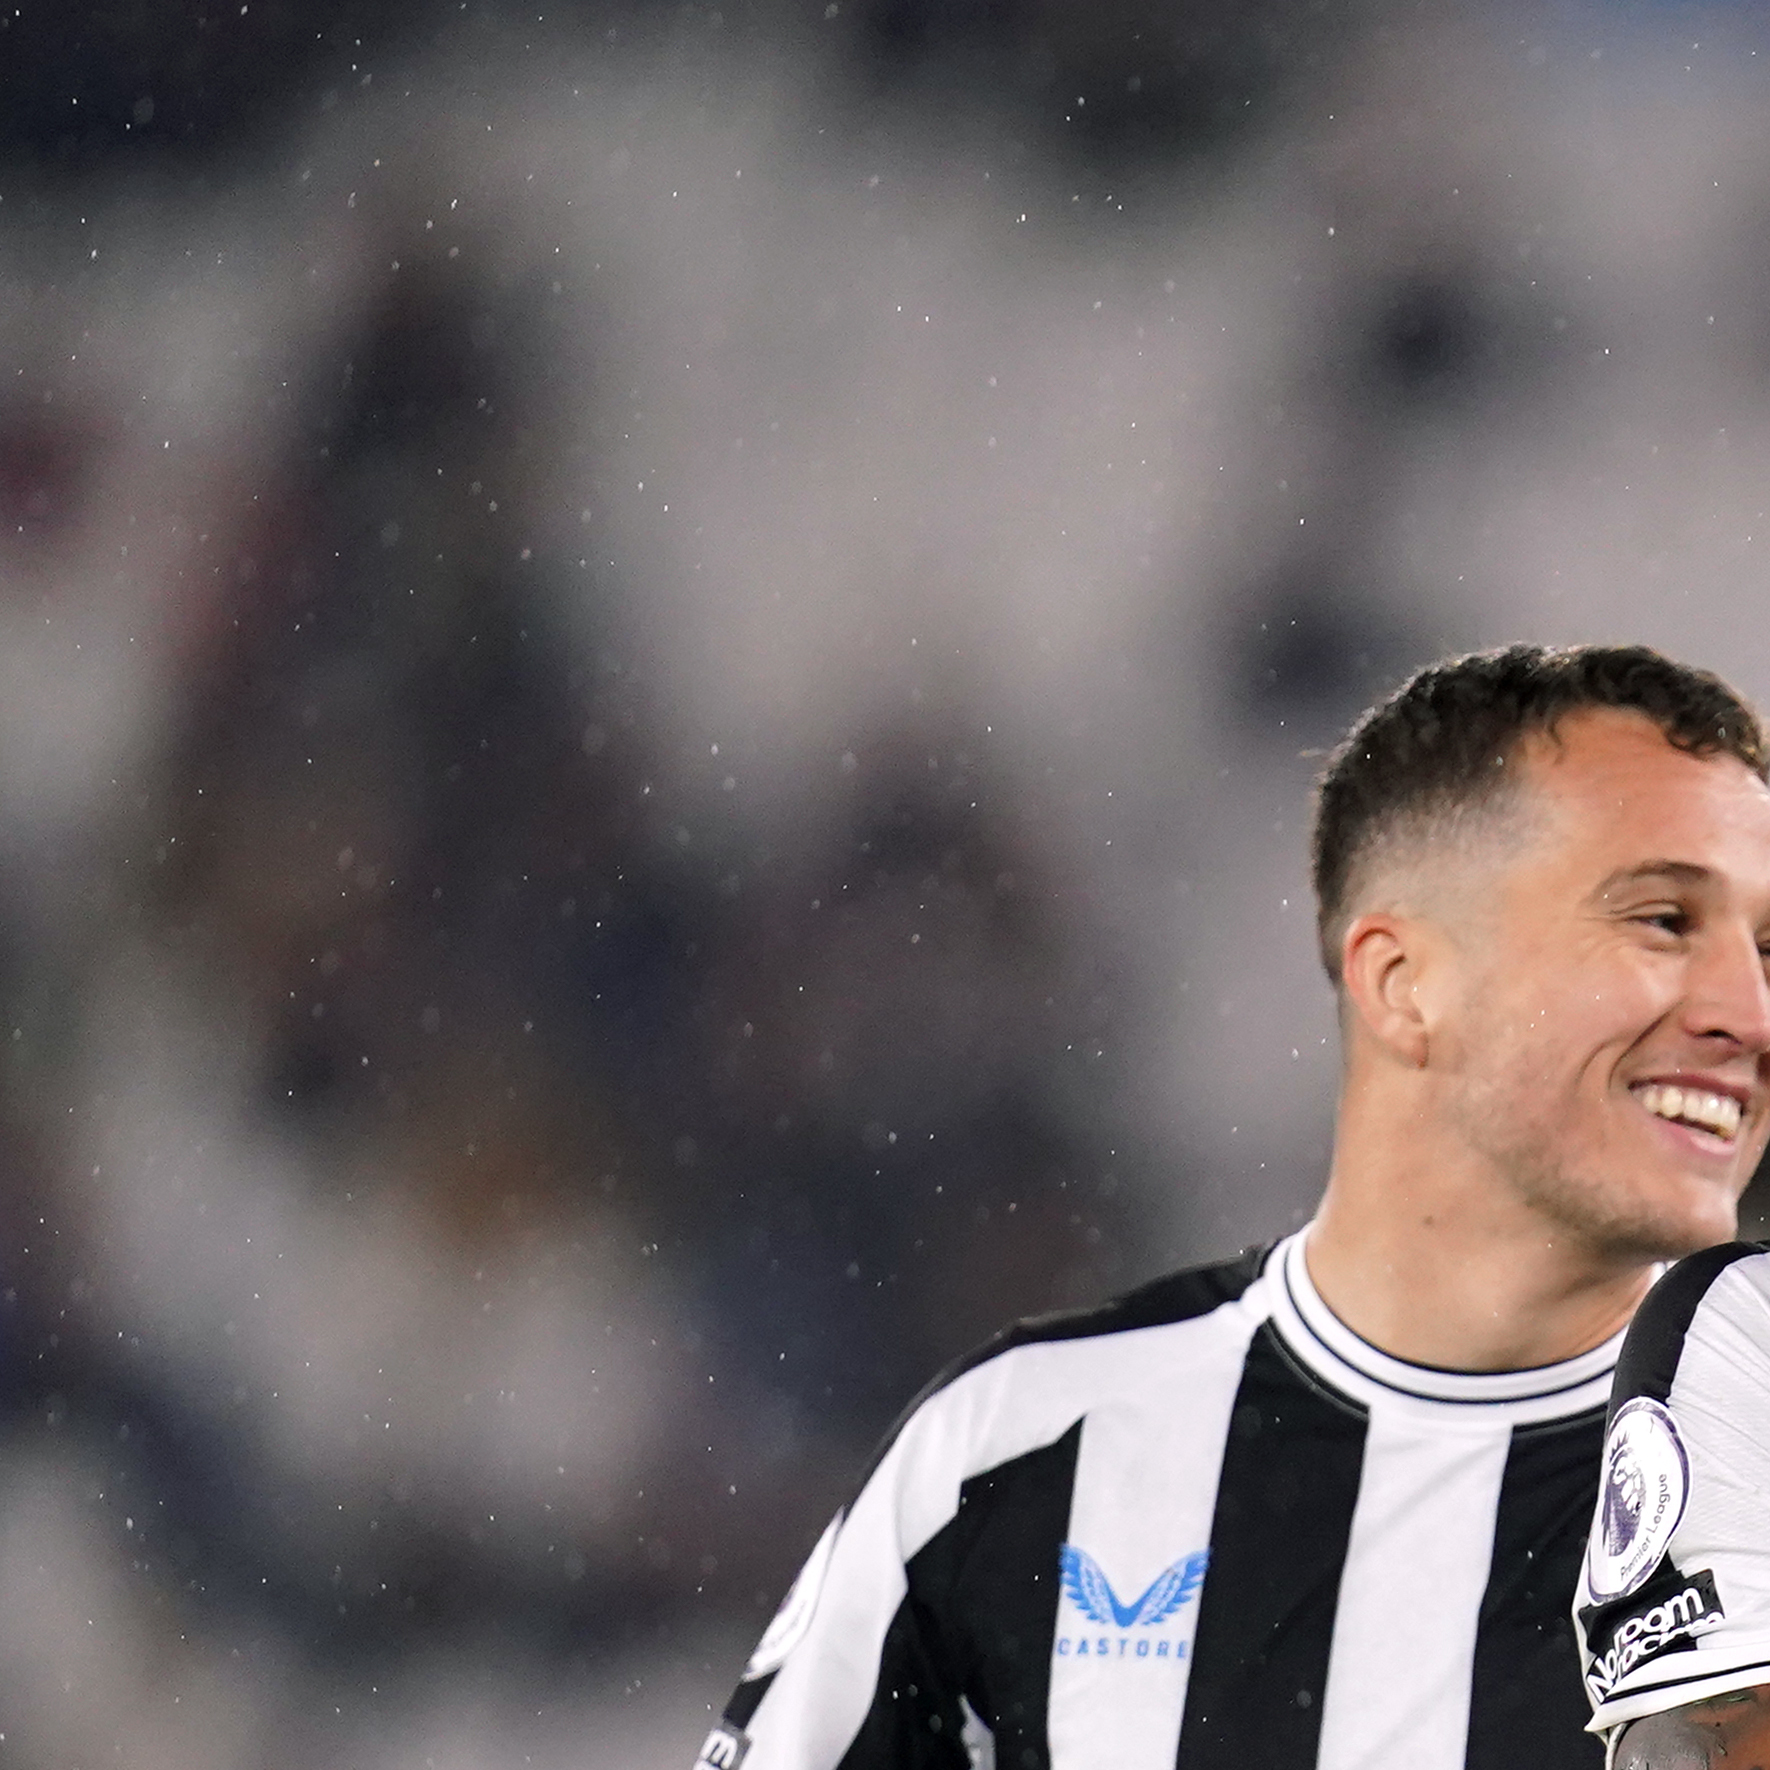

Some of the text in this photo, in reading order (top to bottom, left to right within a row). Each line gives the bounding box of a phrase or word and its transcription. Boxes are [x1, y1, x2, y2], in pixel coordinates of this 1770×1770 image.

[1645, 1473, 1671, 1533] League
[1057, 1637, 1190, 1659] CASTORE
[1586, 1587, 1705, 1704] No room
